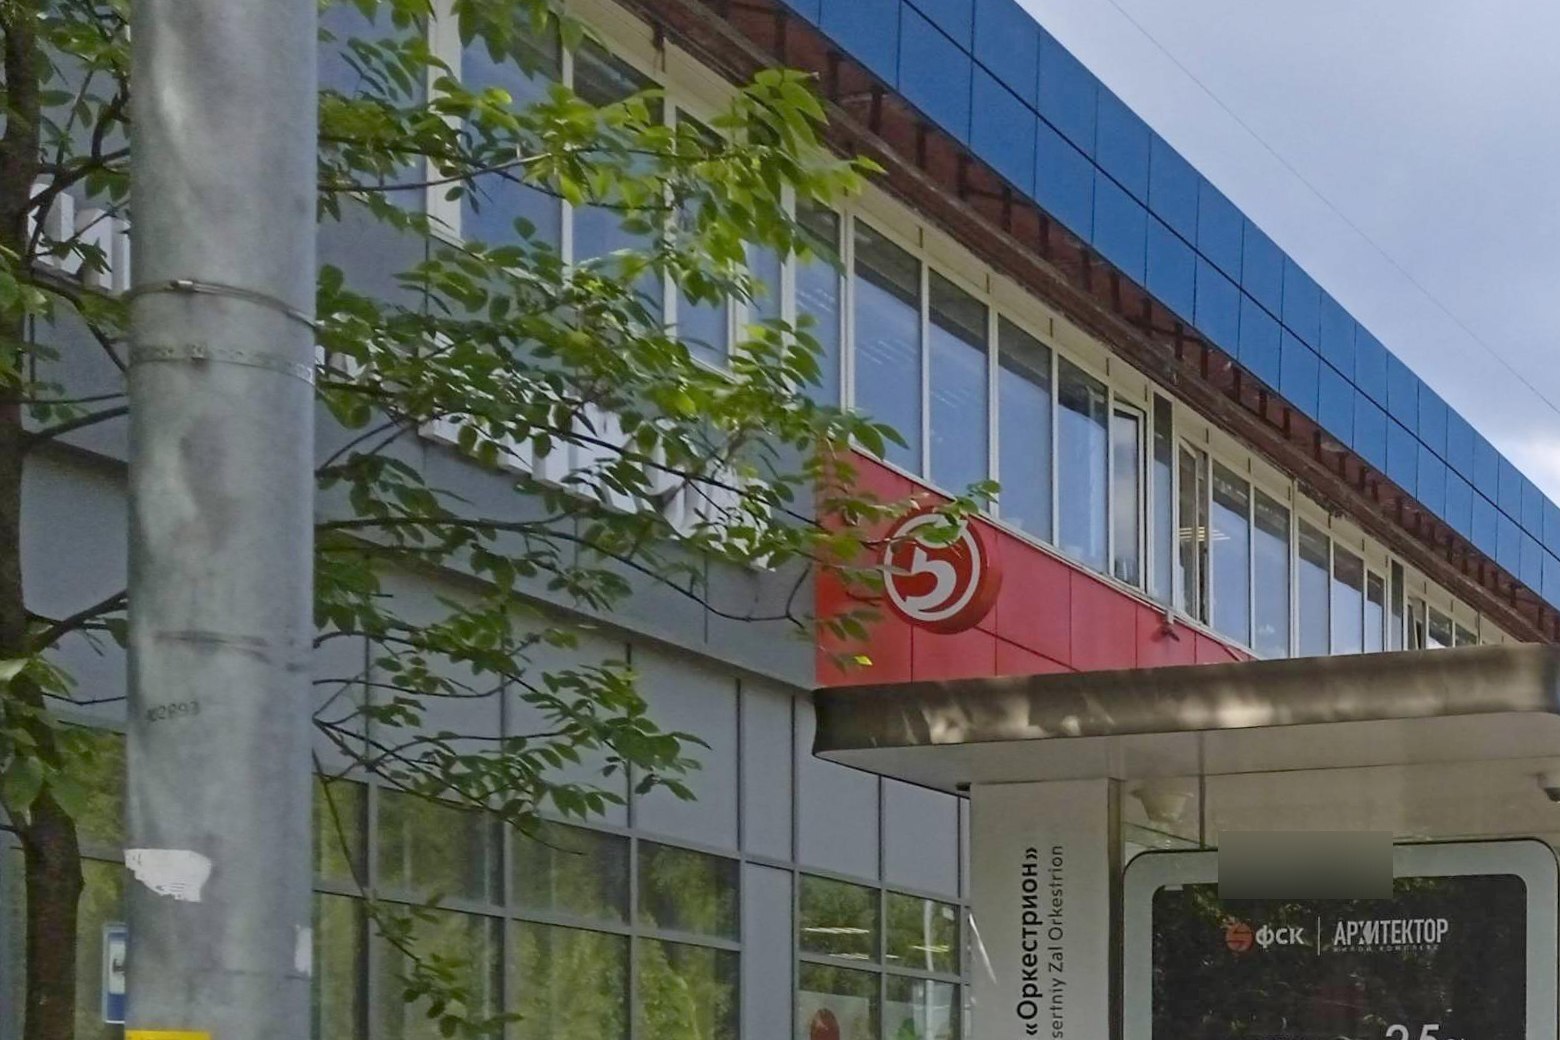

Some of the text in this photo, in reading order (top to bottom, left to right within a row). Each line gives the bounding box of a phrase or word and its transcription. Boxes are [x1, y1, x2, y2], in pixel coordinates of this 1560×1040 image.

[1016, 846, 1043, 1034] «Оркестрион»
[1048, 845, 1064, 941] Orkestrion
[1048, 944, 1064, 974] Zal
